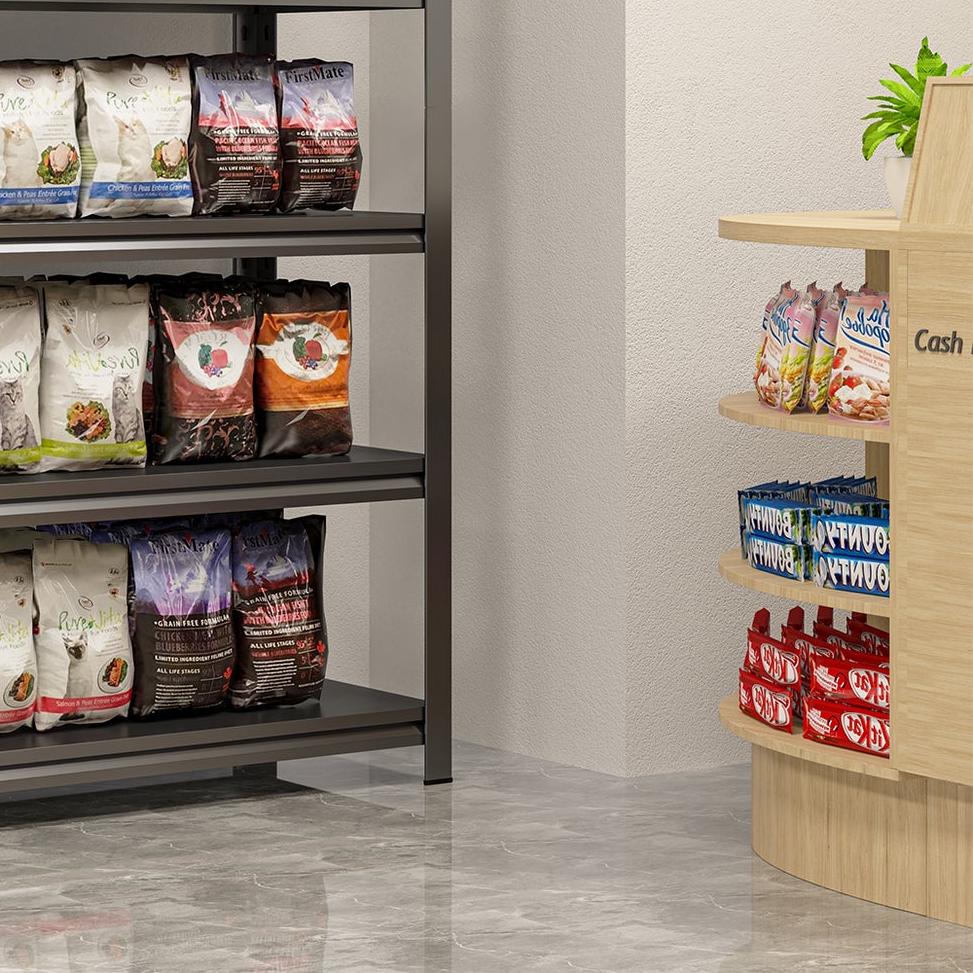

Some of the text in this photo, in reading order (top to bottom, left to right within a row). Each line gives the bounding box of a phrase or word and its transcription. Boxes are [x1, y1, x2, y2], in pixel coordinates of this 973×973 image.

[284, 66, 345, 84] FirstMate
[914, 328, 964, 355] Cash
[150, 536, 220, 555] FirstMate
[57, 610, 90, 631] Pure
[182, 619, 200, 627] FREE
[249, 639, 296, 650] ALL LIFE STAGES
[154, 654, 179, 663] LIMITED
[179, 654, 211, 663] INGREDIENT
[156, 667, 168, 675] ALL
[180, 667, 201, 675] STAGES
[55, 699, 76, 707] Salmon
